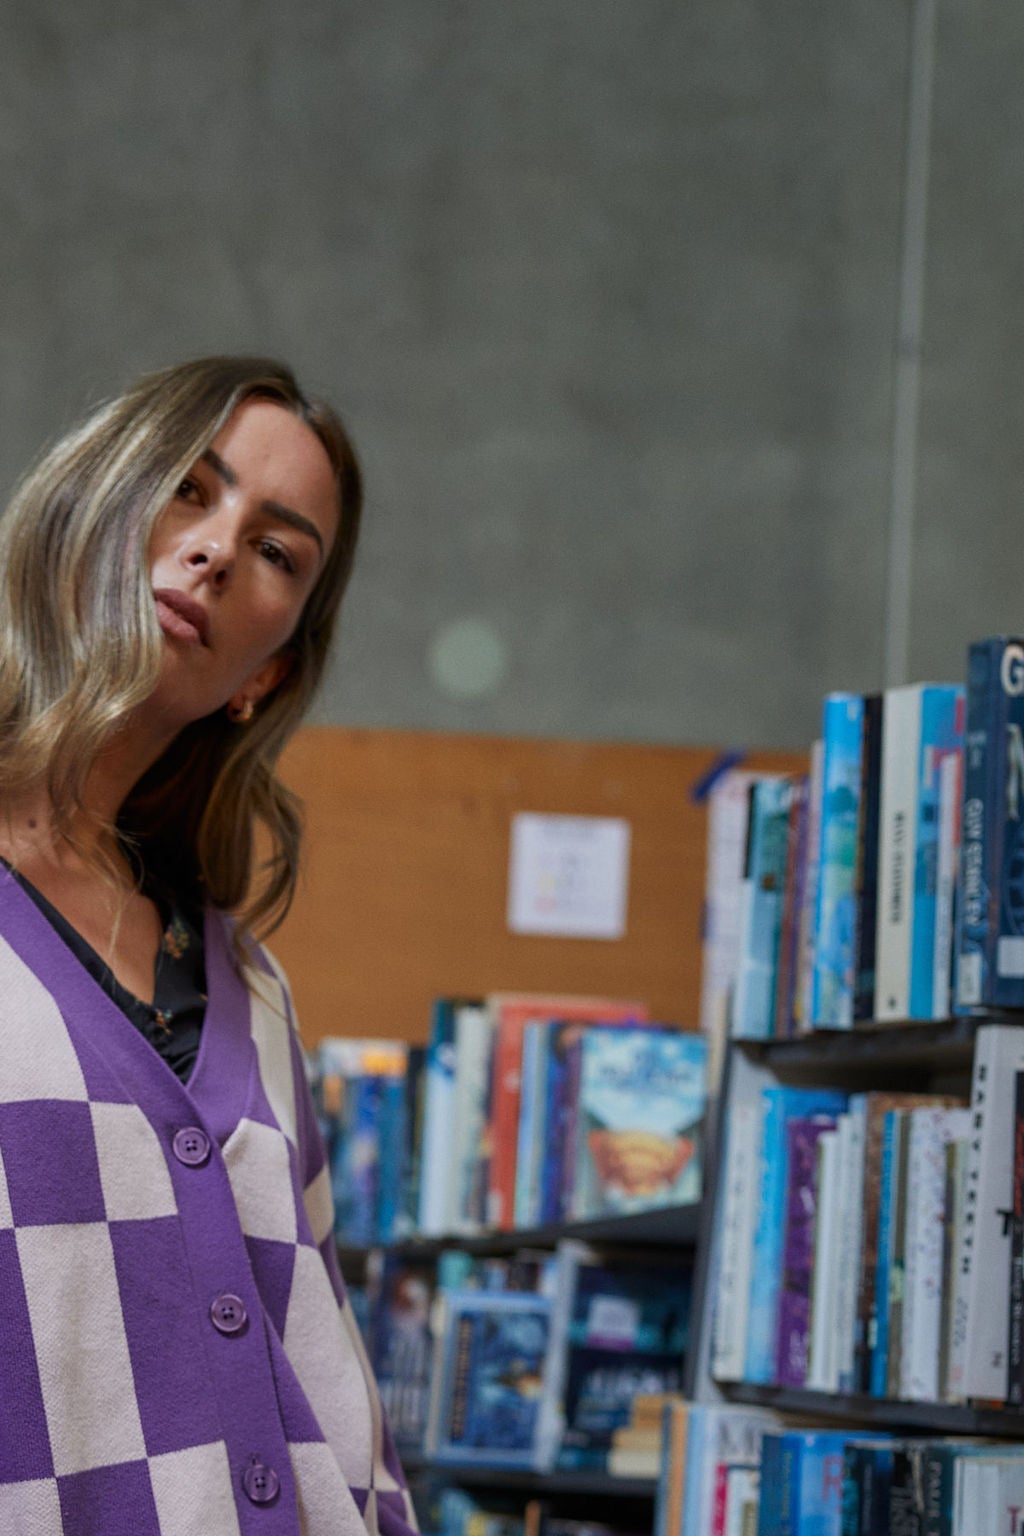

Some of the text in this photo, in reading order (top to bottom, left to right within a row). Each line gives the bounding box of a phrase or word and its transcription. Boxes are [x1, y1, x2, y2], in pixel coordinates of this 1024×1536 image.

[961, 1064, 988, 1274] BABY TEETH
[928, 1461, 943, 1519] PAUL
